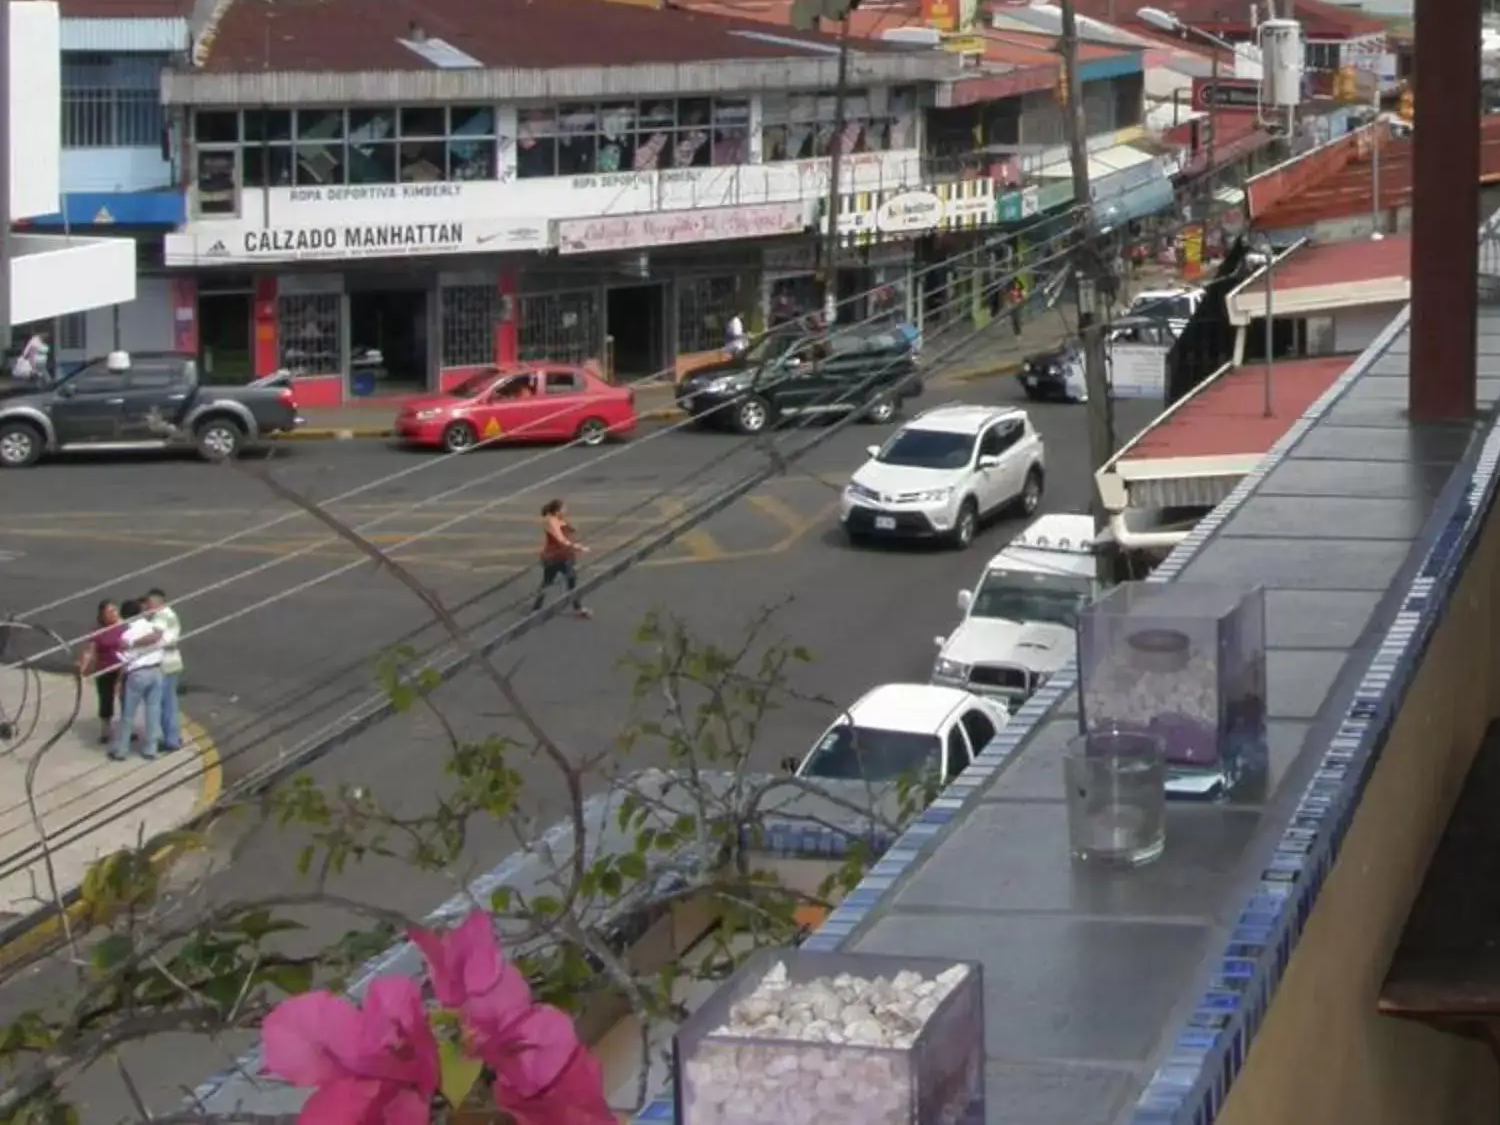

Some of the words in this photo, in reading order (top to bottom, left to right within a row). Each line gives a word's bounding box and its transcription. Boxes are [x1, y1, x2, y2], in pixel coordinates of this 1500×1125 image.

[290, 189, 322, 203] ROPA
[327, 187, 396, 201] DEPORTIVA
[401, 184, 462, 199] KIMBERLY
[244, 227, 337, 252] CALZADO
[344, 223, 464, 248] MANHATTAN
